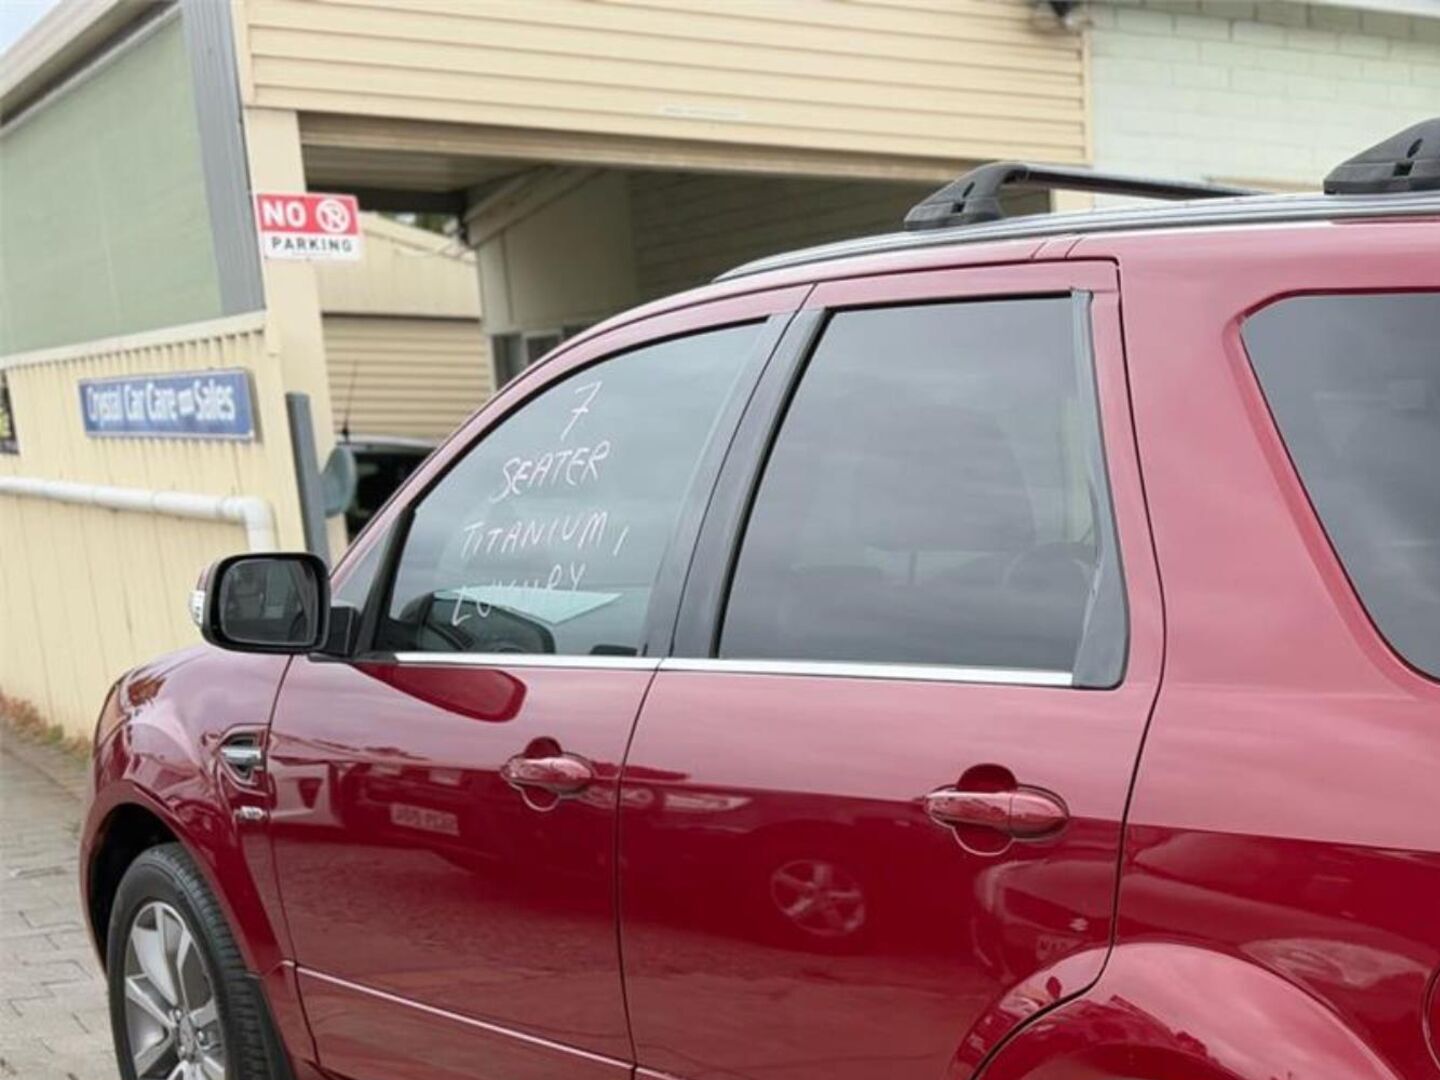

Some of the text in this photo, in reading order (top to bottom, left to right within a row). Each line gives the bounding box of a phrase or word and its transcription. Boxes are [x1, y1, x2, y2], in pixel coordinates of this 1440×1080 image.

[262, 200, 306, 228] NO
[271, 237, 353, 252] PARKING
[124, 384, 145, 420] Car
[146, 382, 178, 421] Care
[193, 378, 236, 421] Sales
[561, 380, 602, 441] 7
[488, 440, 611, 504] SEATER
